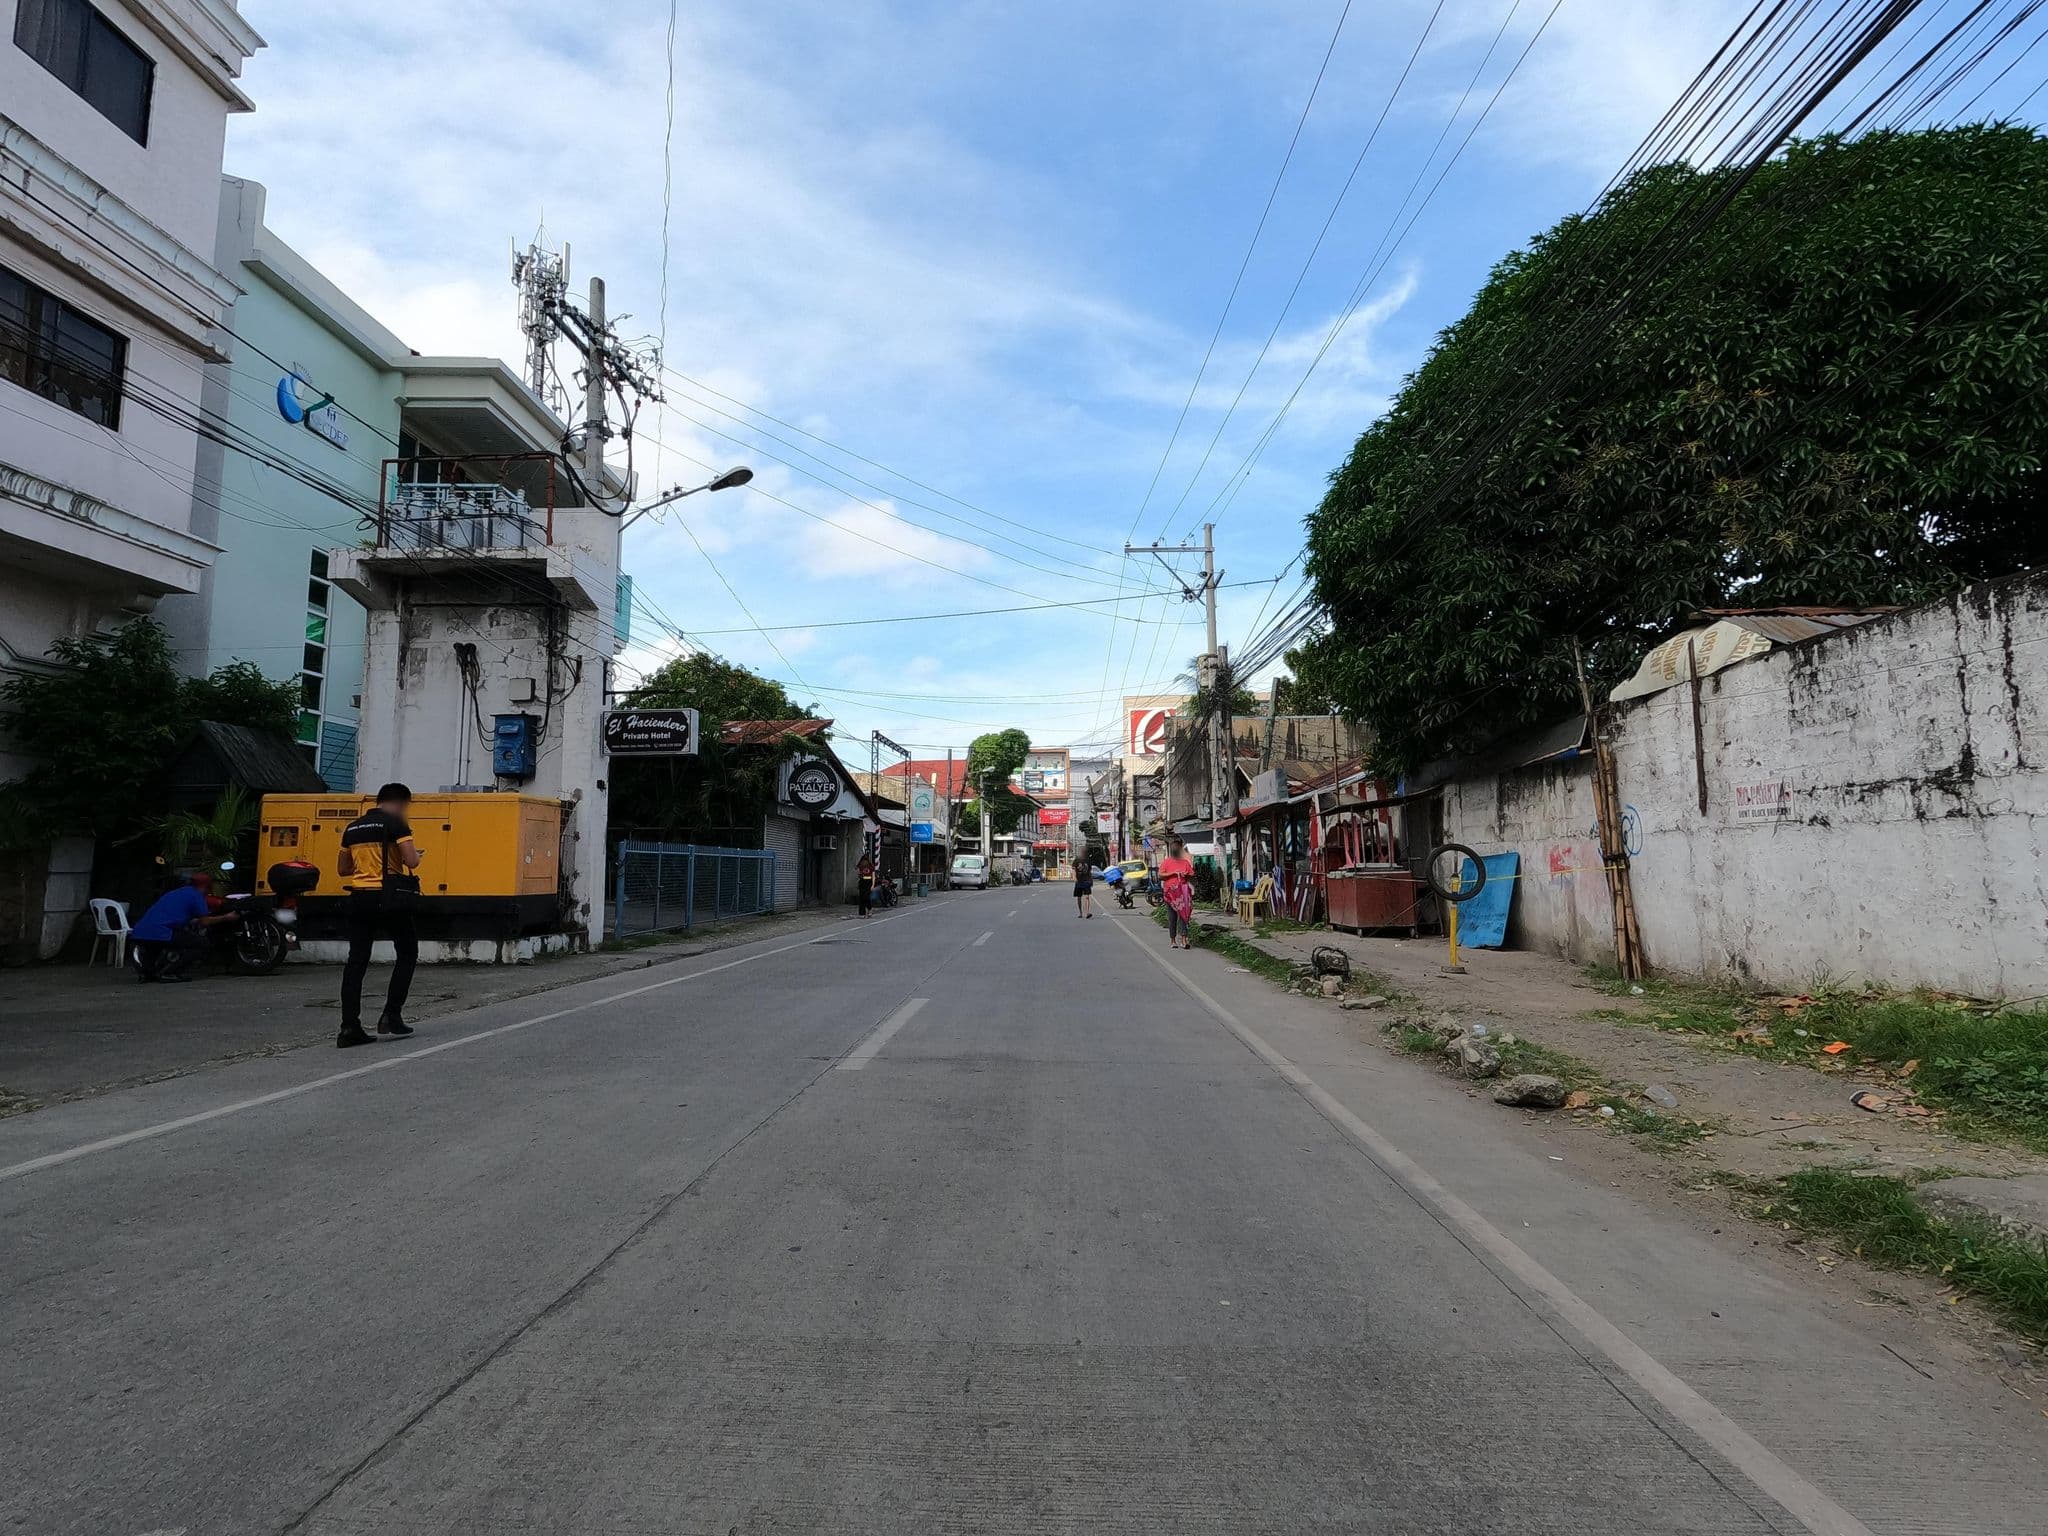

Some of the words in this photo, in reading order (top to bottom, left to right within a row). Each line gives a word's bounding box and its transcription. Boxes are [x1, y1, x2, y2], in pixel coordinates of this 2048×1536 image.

[608, 719, 622, 735] El
[626, 714, 686, 732] Haciendero
[623, 732, 649, 740] Private
[651, 732, 671, 740] Hotel
[789, 783, 836, 792] PATALYER
